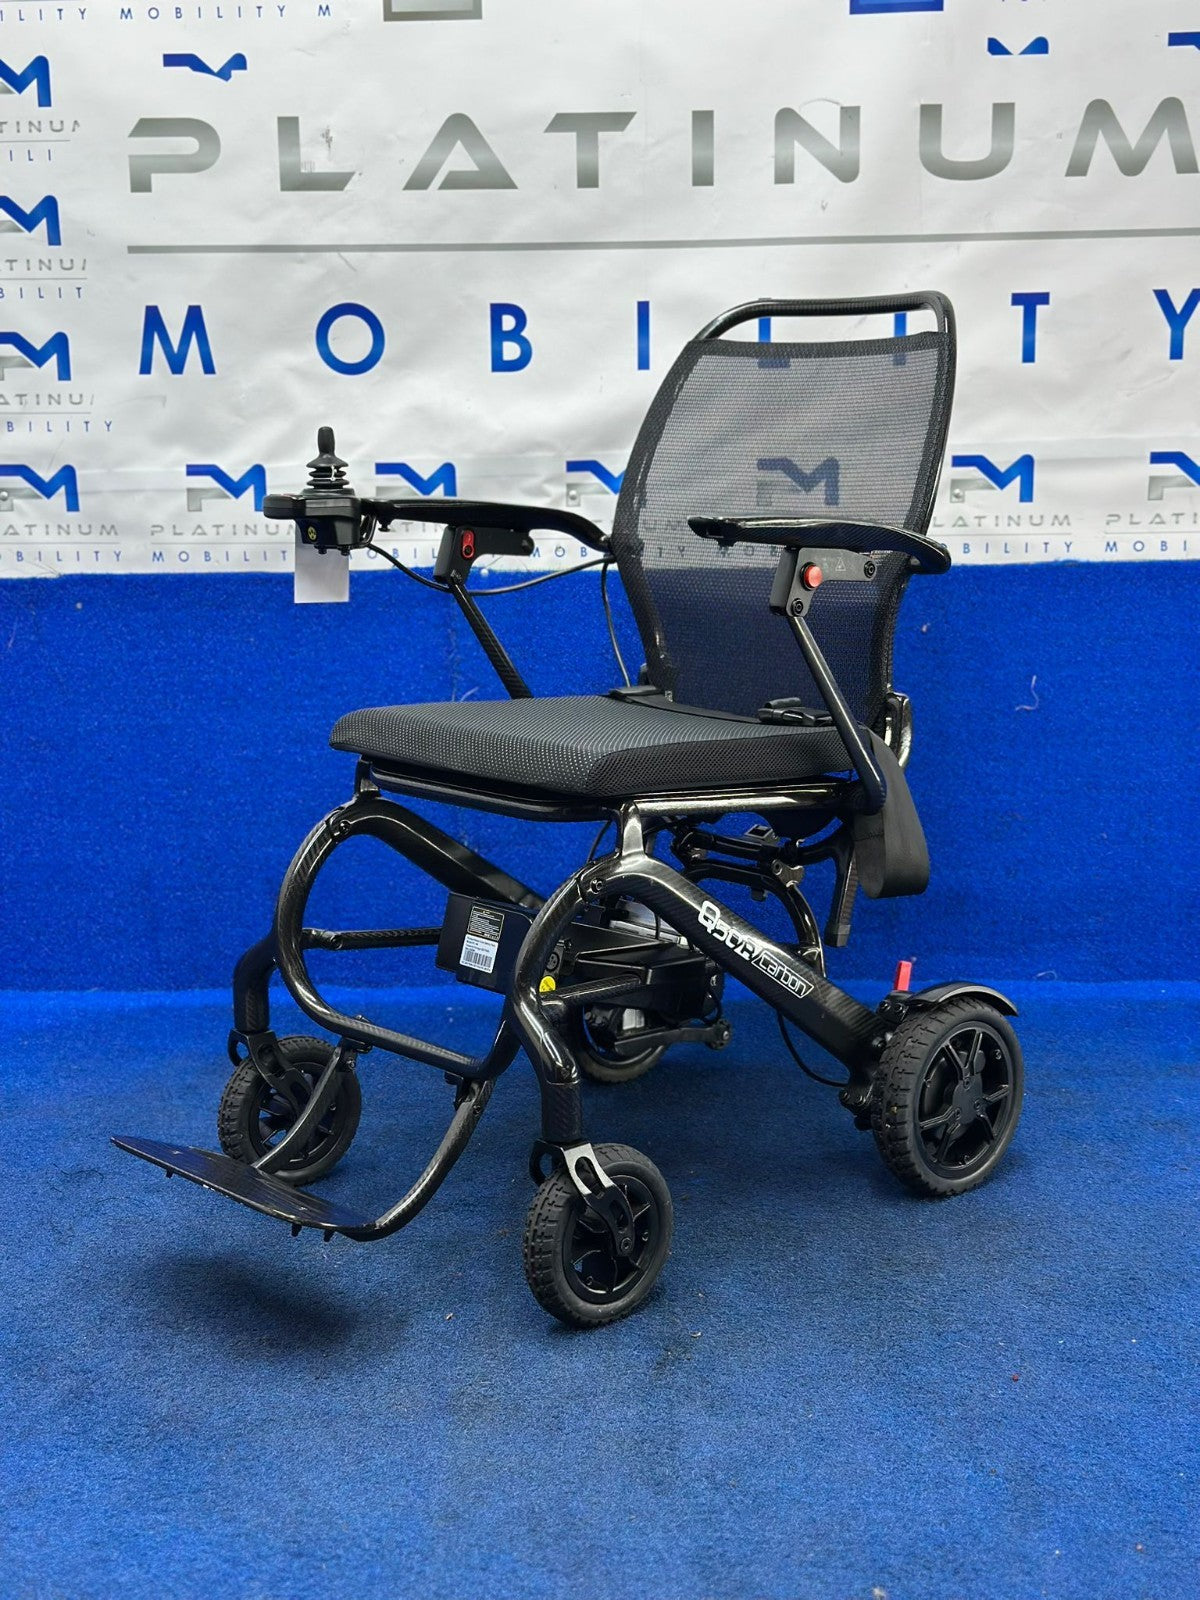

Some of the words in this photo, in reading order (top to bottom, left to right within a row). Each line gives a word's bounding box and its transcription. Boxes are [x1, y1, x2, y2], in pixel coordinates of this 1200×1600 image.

[120, 5, 286, 20] MOBILITY
[127, 96, 1199, 193] PLATINUM
[139, 291, 1200, 375] MOBILITY
